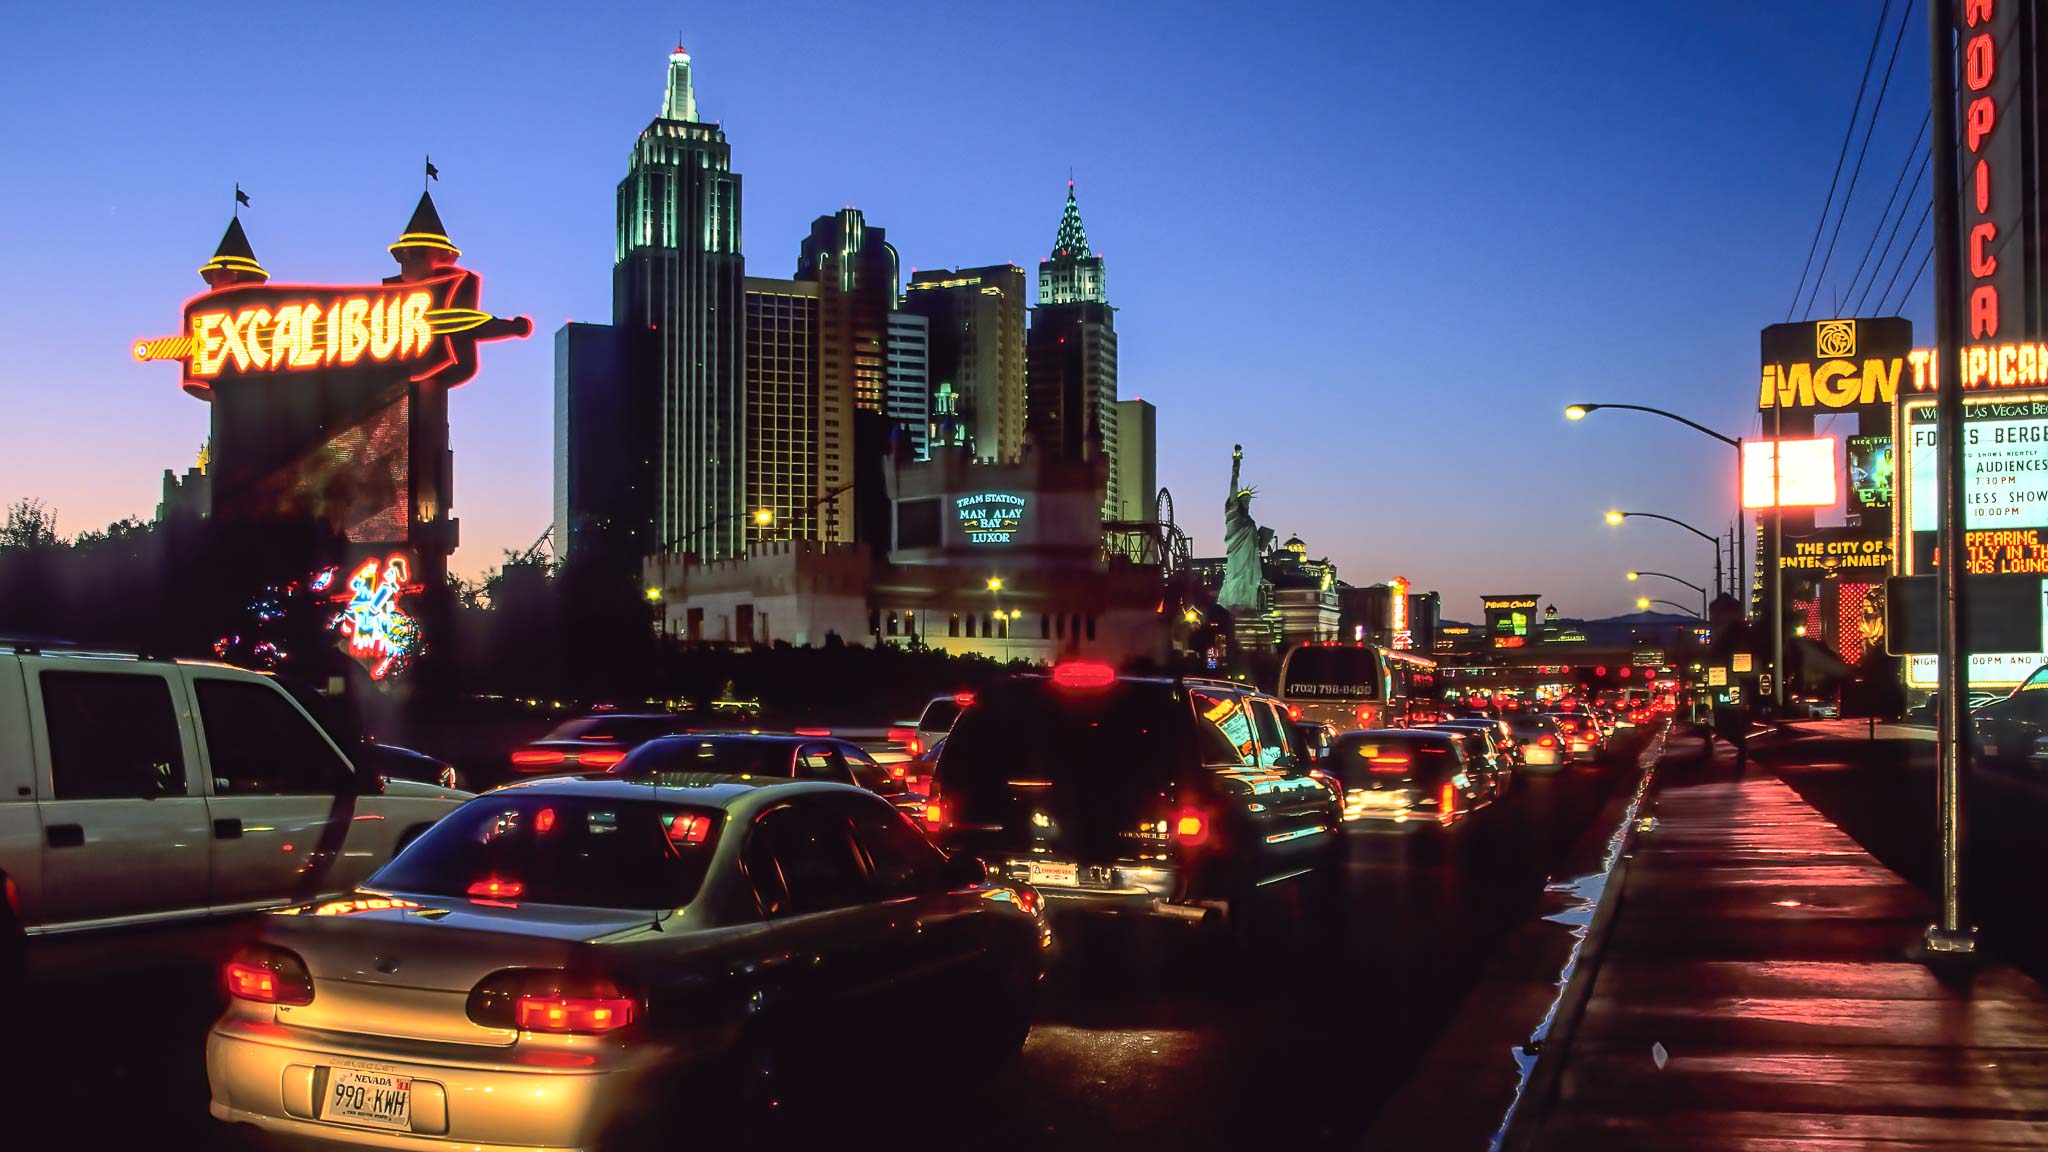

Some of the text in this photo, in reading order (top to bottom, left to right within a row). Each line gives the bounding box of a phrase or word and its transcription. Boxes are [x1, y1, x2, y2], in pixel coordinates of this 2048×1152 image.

[199, 292, 434, 376] EXCALIBUR
[1760, 358, 1904, 408] MGM
[1965, 404, 1988, 418] LAS
[1992, 404, 2029, 417] VEGAS
[1976, 460, 2048, 473] AUDIENCES
[957, 493, 1025, 507] TRAM STATION
[1968, 490, 2048, 504] LESS SHOW
[960, 509, 1022, 519] MAN ALAY
[980, 518, 1002, 528] BAY
[972, 533, 1010, 543] LUXOR
[1965, 530, 2038, 546] PPEARING
[1796, 541, 1883, 555] THE CITY OF
[2006, 545, 2024, 559] IN
[2010, 656, 2031, 664] AND
[1290, 684, 1317, 695] (702)
[355, 1074, 392, 1087] NEVADA
[335, 1083, 407, 1116] 990 KWH
